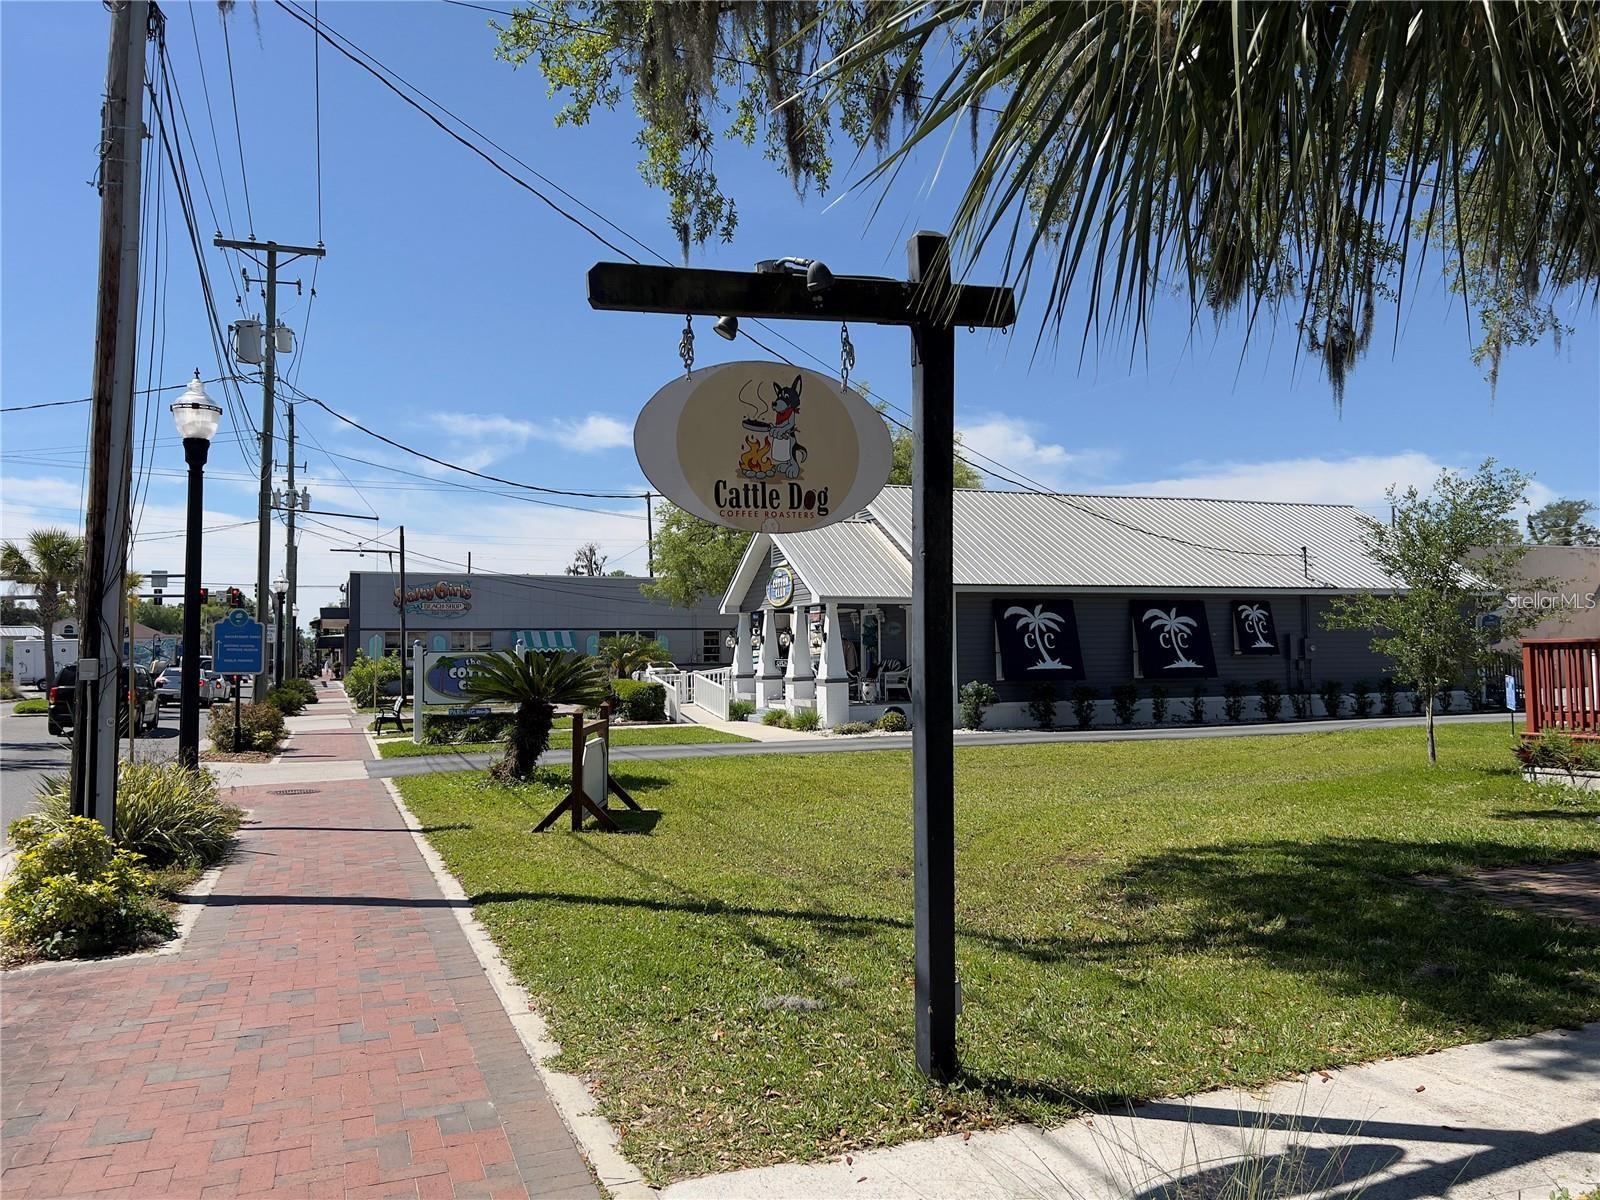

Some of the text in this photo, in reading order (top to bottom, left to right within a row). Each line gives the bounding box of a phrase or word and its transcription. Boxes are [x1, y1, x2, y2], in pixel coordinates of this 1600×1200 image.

[714, 479, 829, 517] Cattle Dog
[719, 509, 816, 519] COFFEE ROASTERS
[434, 580, 472, 600] Girls
